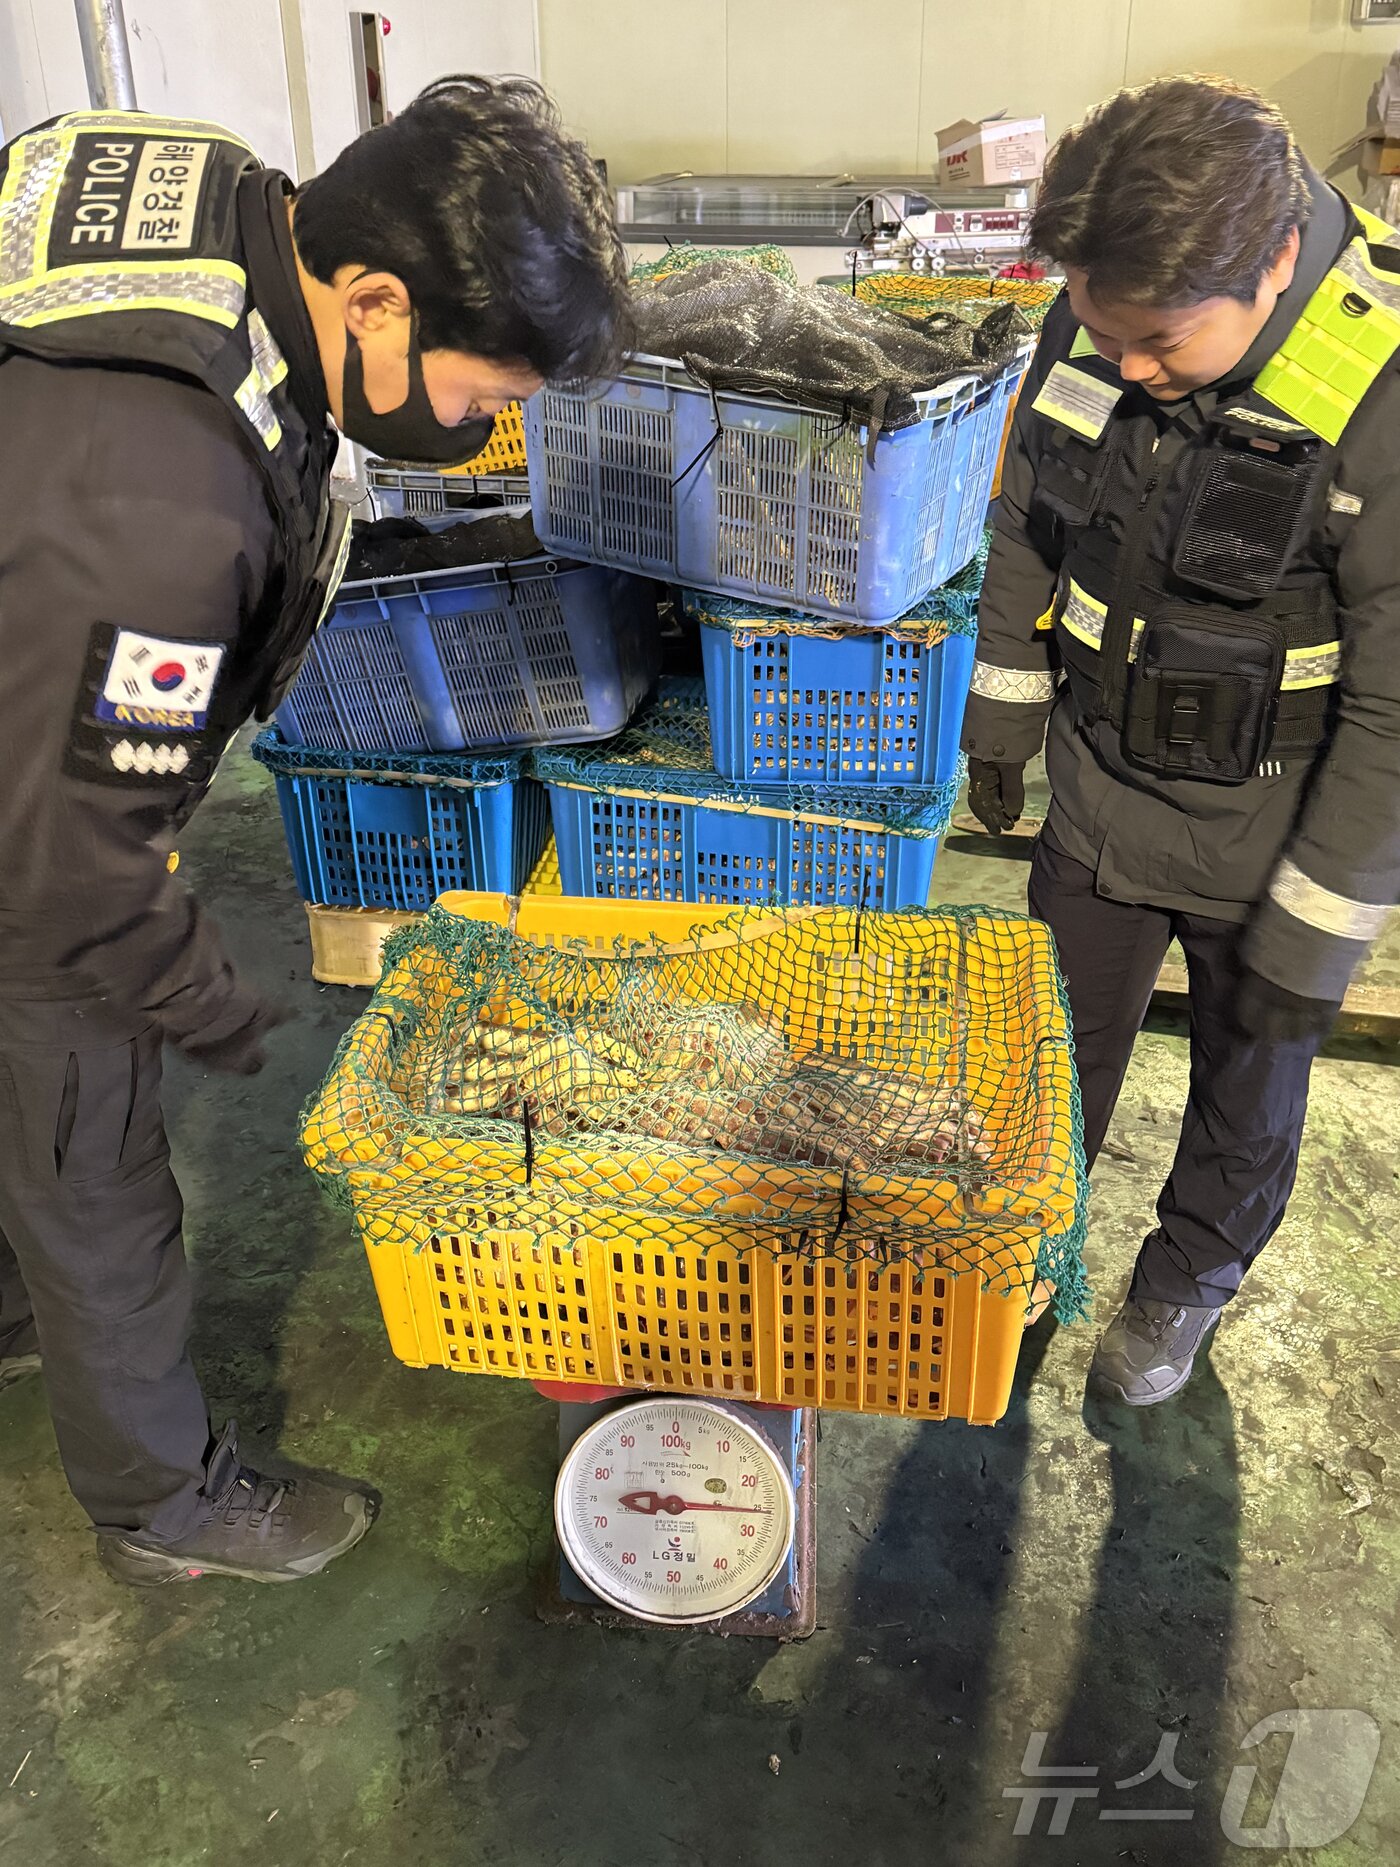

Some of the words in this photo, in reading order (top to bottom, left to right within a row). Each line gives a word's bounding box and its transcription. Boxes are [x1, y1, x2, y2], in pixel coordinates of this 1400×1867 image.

[70, 143, 135, 244] POLICE
[137, 145, 194, 243] 해양경찰
[672, 1421, 680, 1433] 0
[620, 1435, 635, 1448] 90
[661, 1435, 691, 1450] 100kg
[716, 1440, 730, 1453] 10
[595, 1468, 610, 1480] 80
[741, 1474, 756, 1487] 20
[594, 1516, 608, 1528] 70
[740, 1524, 755, 1537] 30
[622, 1552, 636, 1564] 60
[737, 1548, 745, 1556] 35
[713, 1558, 728, 1570] 40
[666, 1571, 681, 1583] 50
